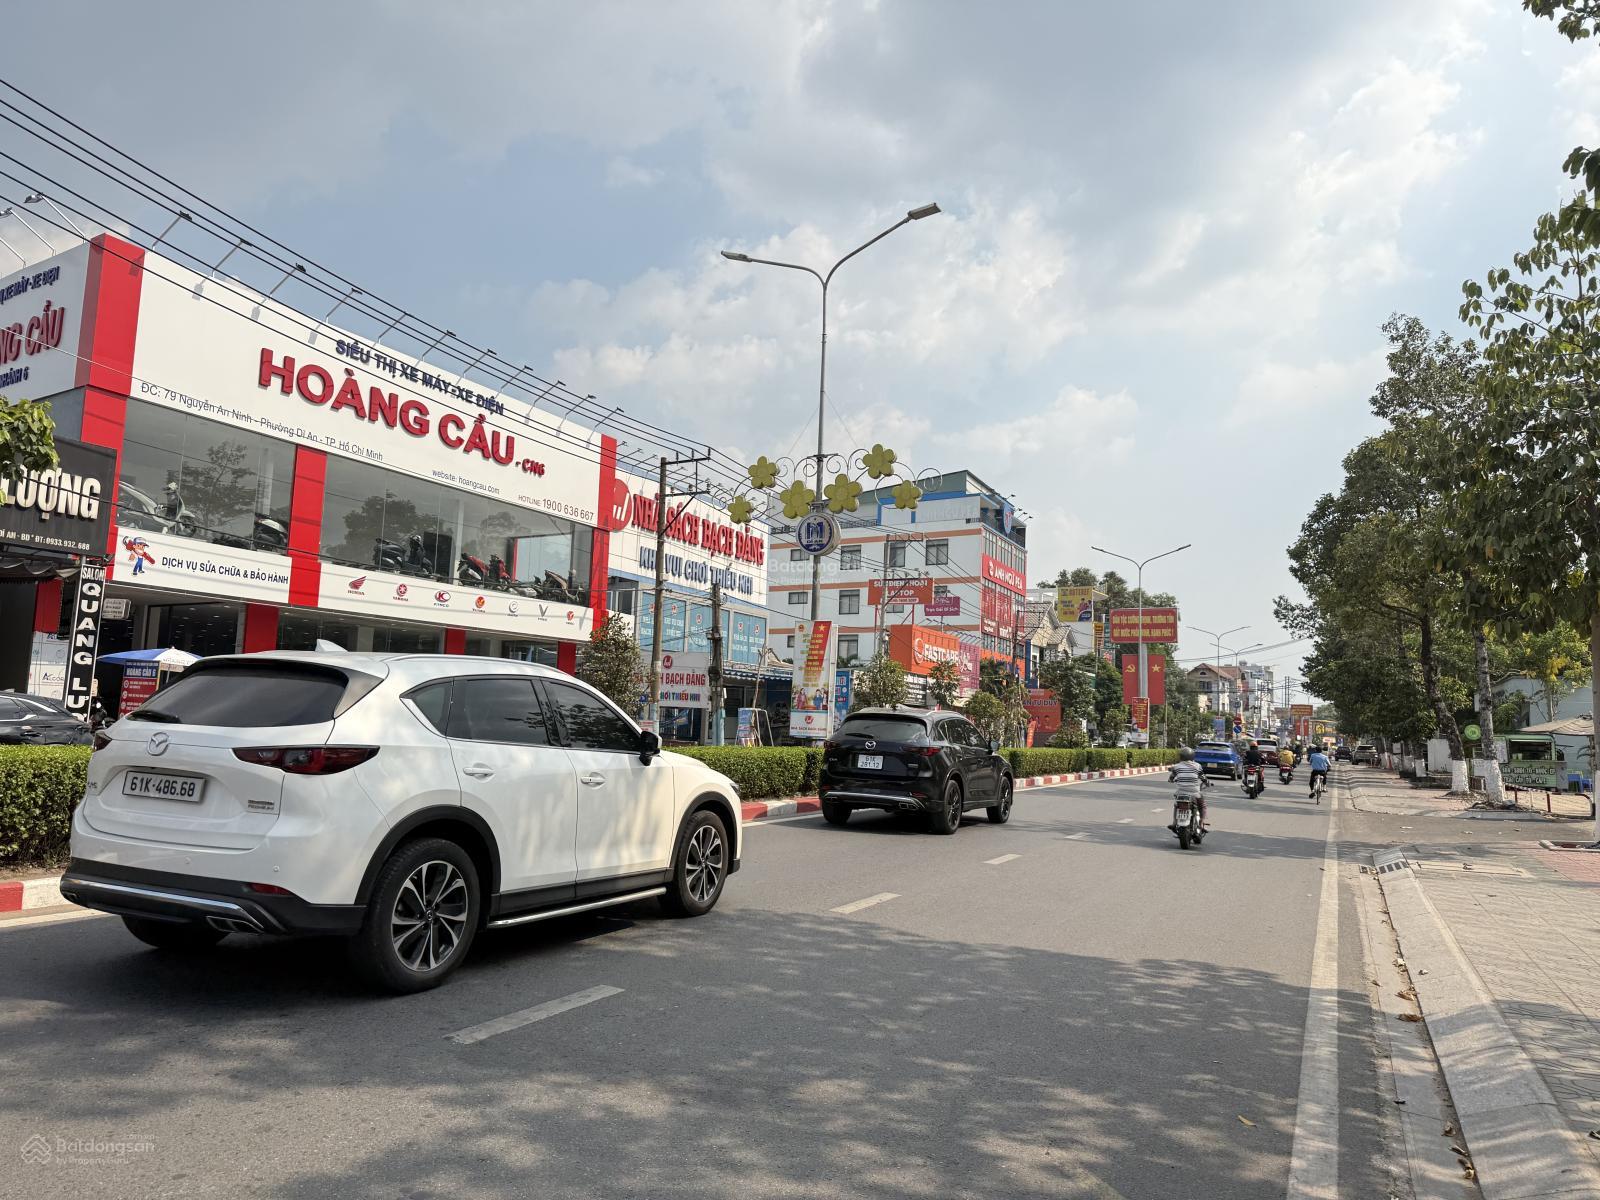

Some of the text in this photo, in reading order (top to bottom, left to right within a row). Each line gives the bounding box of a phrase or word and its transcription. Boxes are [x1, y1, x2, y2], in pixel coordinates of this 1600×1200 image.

[0, 300, 64, 365] NG CẦU
[335, 339, 371, 364] SIÊU
[374, 353, 397, 378] THỊ
[400, 364, 419, 383] XE
[475, 393, 504, 416] ĐIỆN
[141, 382, 161, 397] ĐC:
[164, 389, 177, 401] 79
[179, 393, 214, 413] Nguyễn
[217, 405, 230, 416] An
[232, 409, 252, 423] Ninh
[260, 417, 294, 437] Phường
[307, 432, 318, 442] An
[339, 440, 350, 451] Hồ
[351, 444, 364, 455] Chí
[366, 448, 383, 461] Minh
[258, 347, 430, 437] HOÀNG
[438, 413, 515, 466] CẦU
[1, 464, 101, 520] LƯỢNG
[432, 469, 500, 495] website: hoangcau.com
[543, 498, 562, 513] 1900
[564, 504, 579, 518] 636
[580, 508, 594, 521] 667
[665, 502, 700, 545] SÁCH
[701, 518, 735, 558] BẠCH
[6, 530, 16, 540] AN
[21, 533, 30, 541] BD
[82, 567, 105, 581] SALON
[161, 557, 288, 584] DỊCH VỤ SỬA CHỮA & BẢO HÀNH
[640, 546, 658, 571] KH
[665, 553, 683, 578] VUI
[684, 560, 708, 584] CHƠI
[738, 573, 753, 595] NHI
[994, 565, 1005, 581] ANH
[74, 582, 101, 665] QUANG
[665, 673, 685, 688] BẠCH
